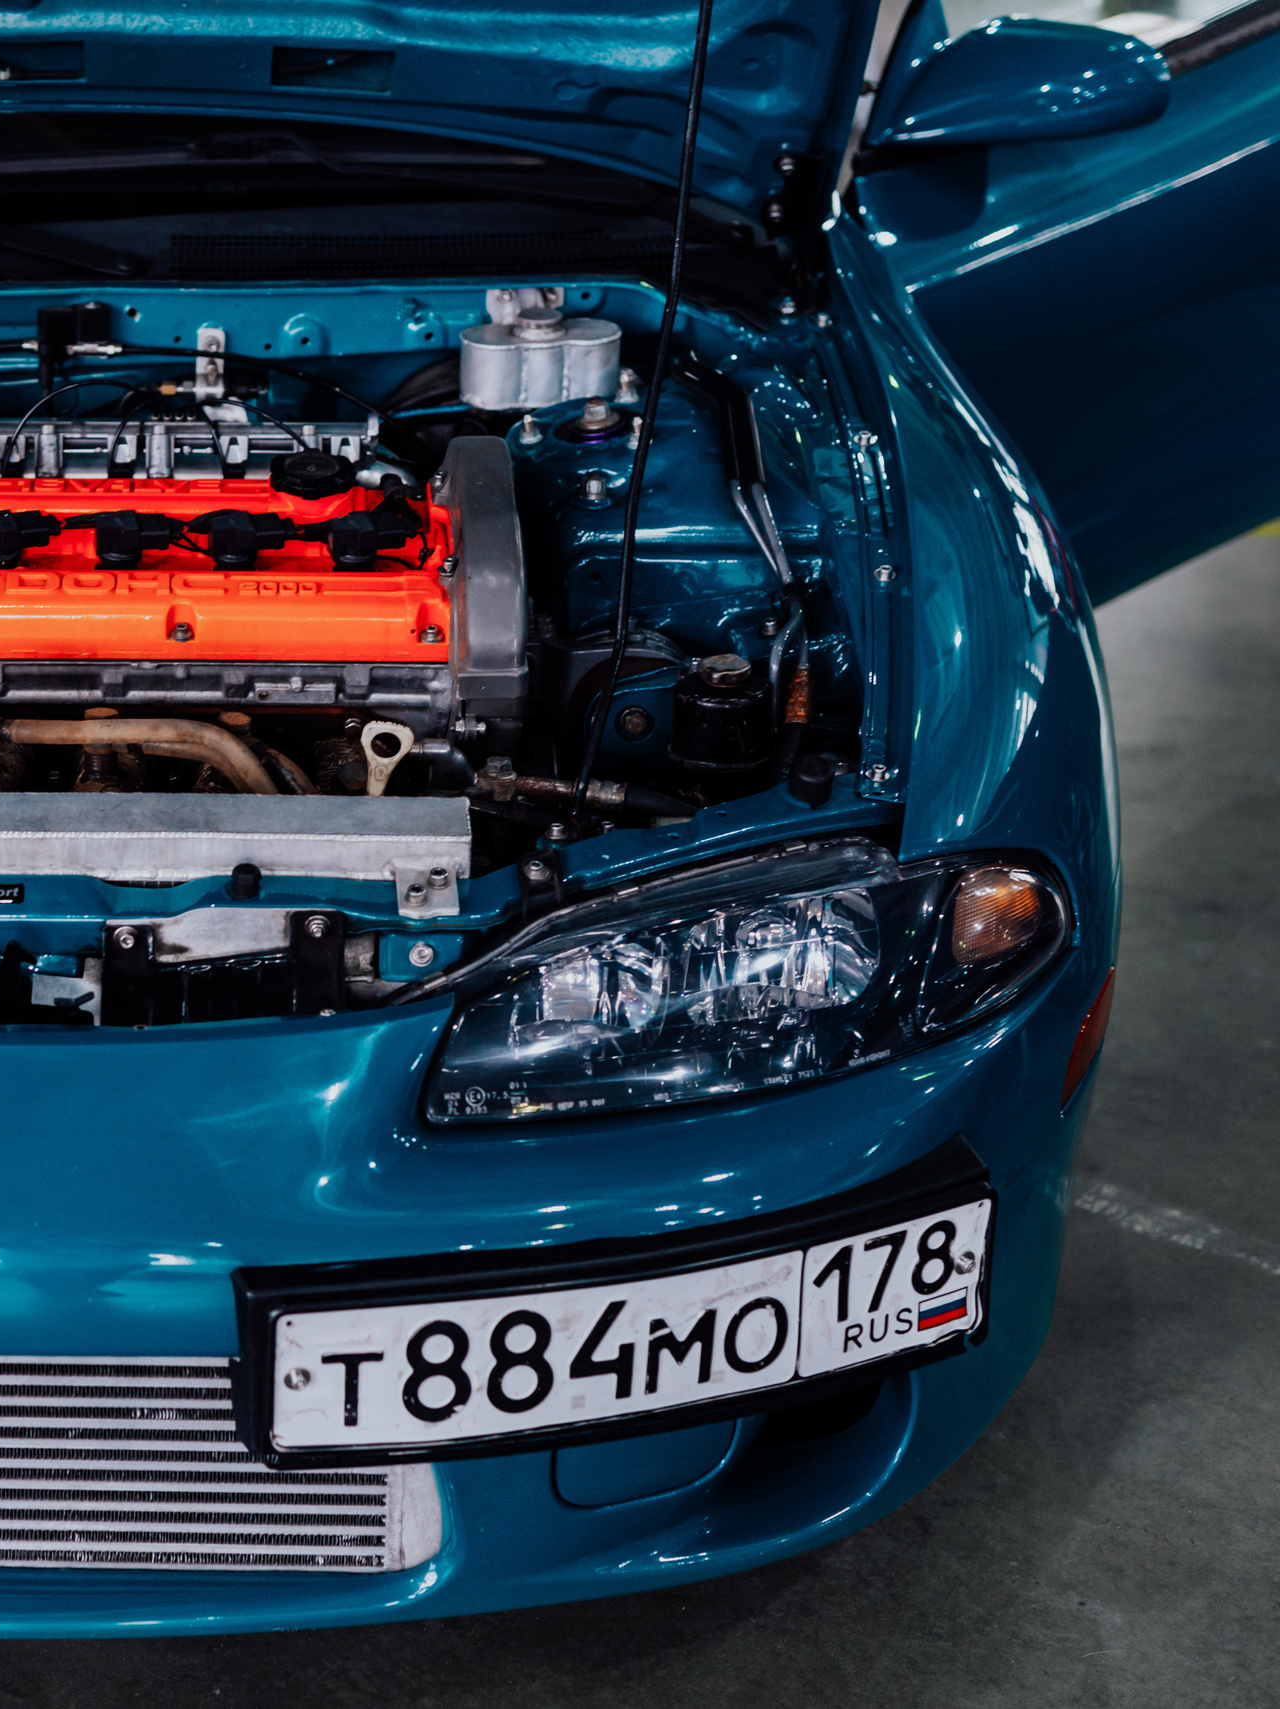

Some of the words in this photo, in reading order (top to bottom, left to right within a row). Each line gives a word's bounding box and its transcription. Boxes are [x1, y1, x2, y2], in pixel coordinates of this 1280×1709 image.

[6, 572, 225, 596] DOHC
[237, 581, 318, 596] 2000
[812, 1219, 957, 1323] 178
[322, 1296, 789, 1427] T884MO
[842, 1308, 913, 1353] RUS
